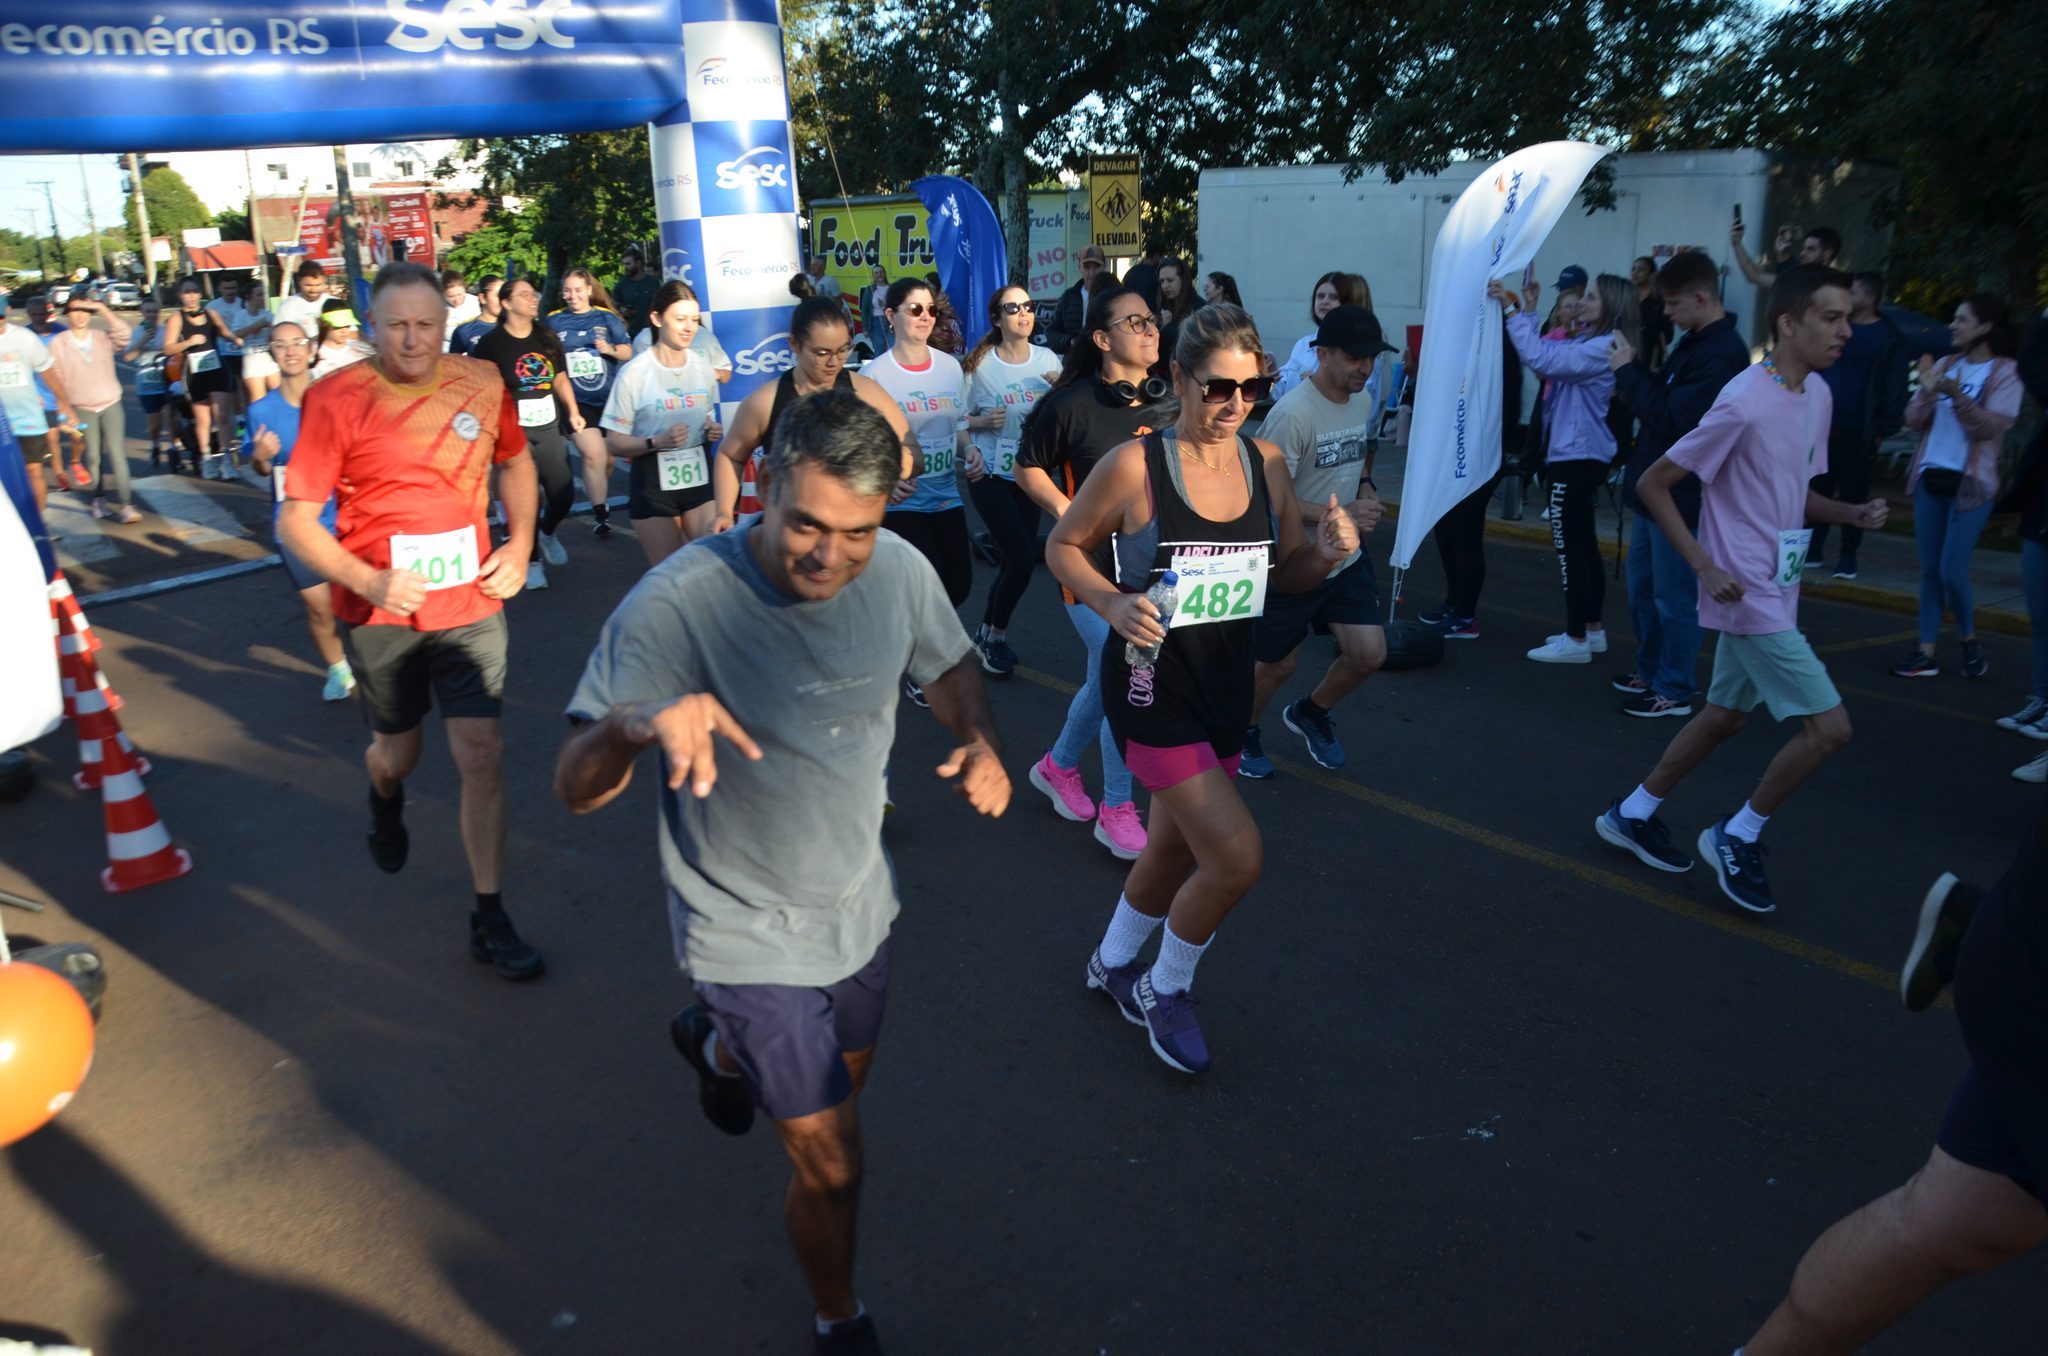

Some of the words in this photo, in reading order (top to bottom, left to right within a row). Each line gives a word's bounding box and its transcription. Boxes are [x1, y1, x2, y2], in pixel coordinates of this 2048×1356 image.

[0, 14, 257, 56] ecomércio
[266, 17, 330, 55] RS
[715, 161, 788, 190] Sesc
[1093, 160, 1137, 172] DEVAGAR
[1028, 208, 1065, 229] ruck
[818, 216, 882, 269] Food
[893, 213, 937, 268] Tru
[1096, 232, 1138, 247] ELEVADA
[1037, 246, 1067, 267] NO
[572, 359, 599, 374] 432
[1454, 398, 1466, 480] Fecomércio
[667, 462, 703, 486] 361
[1550, 482, 1568, 549] GROWTH
[1180, 567, 1206, 577] Sesc
[1181, 578, 1255, 620] 482
[1719, 845, 1742, 876] FILA
[1139, 971, 1159, 1011] MAFIA
